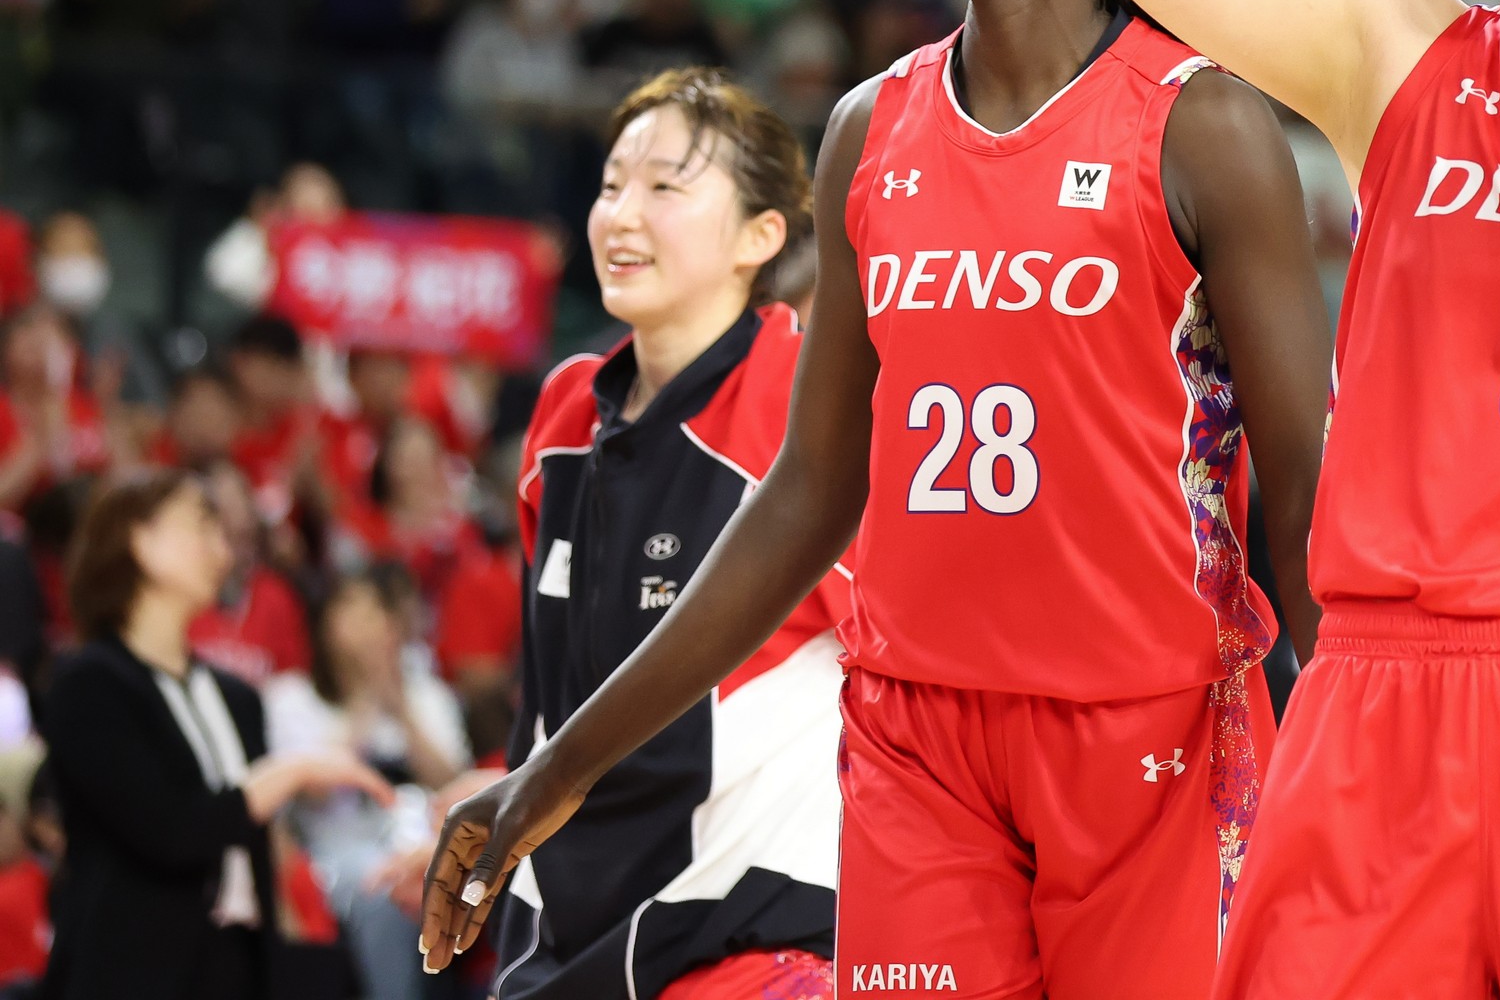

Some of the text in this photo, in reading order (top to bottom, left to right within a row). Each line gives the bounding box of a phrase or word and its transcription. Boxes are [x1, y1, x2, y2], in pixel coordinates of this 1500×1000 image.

[1074, 168, 1102, 188] W
[867, 250, 1119, 318] DENSO
[907, 382, 1040, 516] 28
[852, 963, 958, 992] KARIYA
